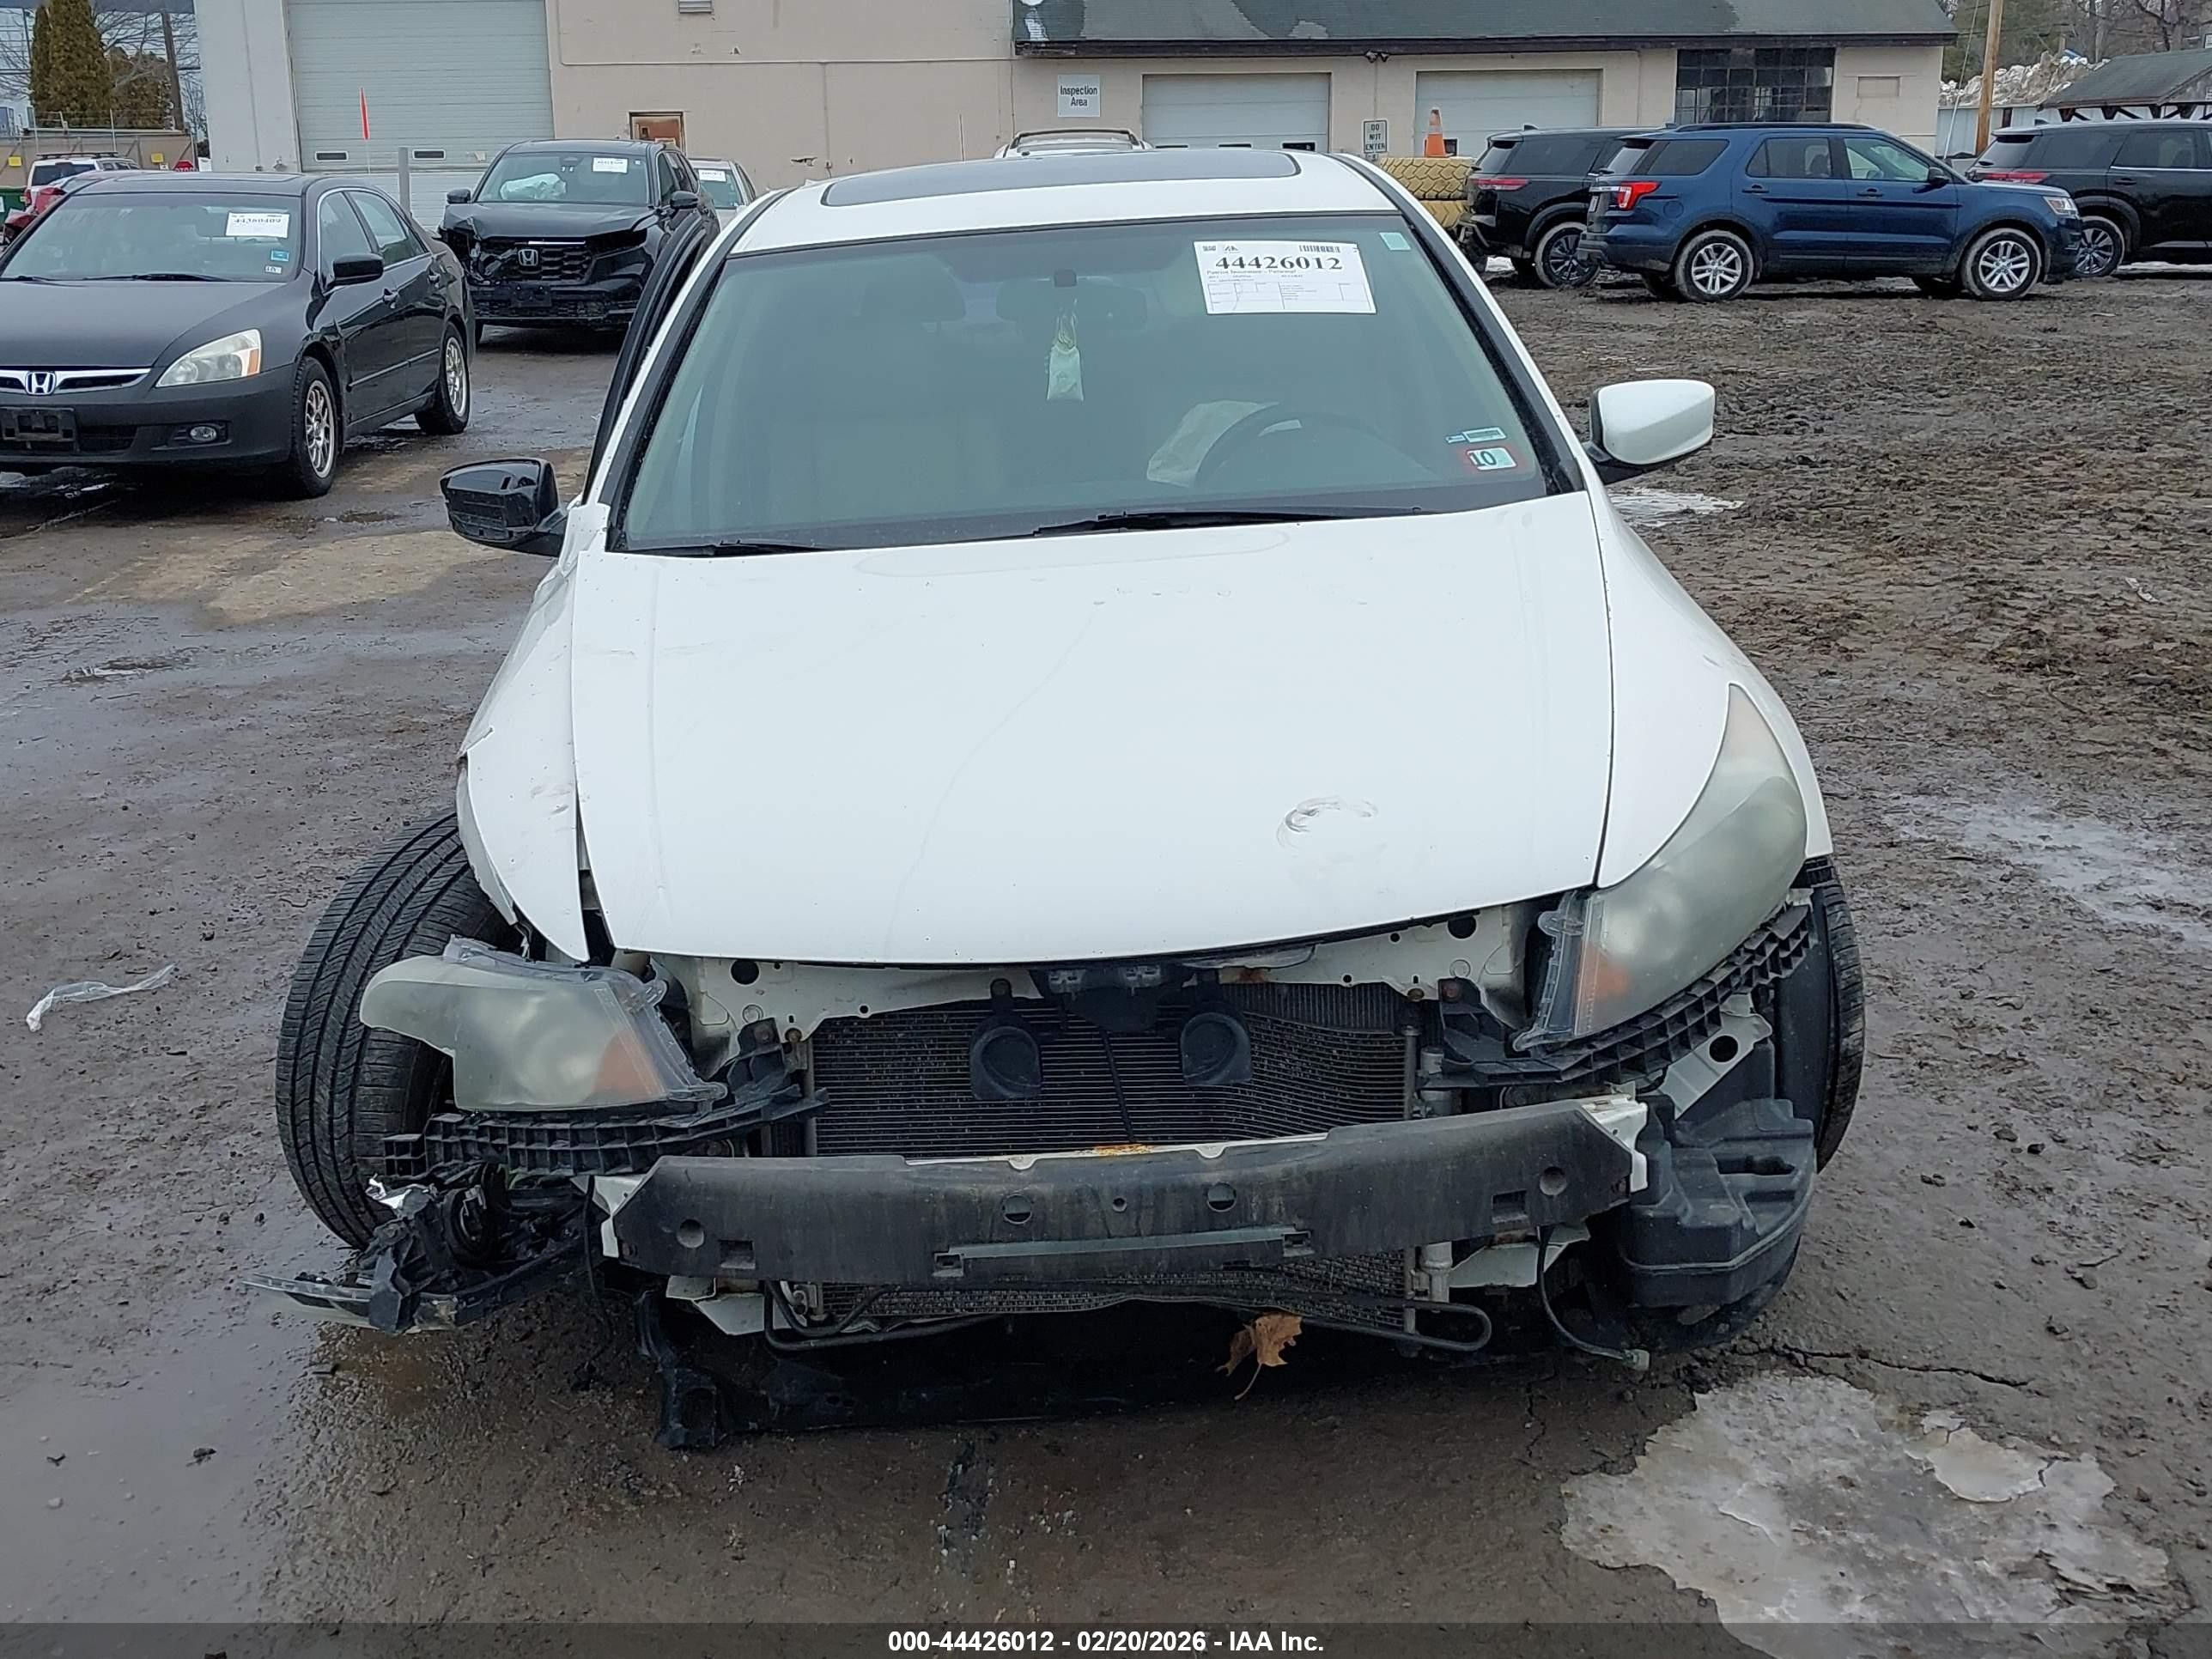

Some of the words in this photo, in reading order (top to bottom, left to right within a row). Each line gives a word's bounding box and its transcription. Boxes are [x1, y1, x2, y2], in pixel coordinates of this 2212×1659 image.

[1060, 85, 1098, 96] Inspection
[1070, 96, 1088, 106] Area
[1215, 256, 1343, 270] 44426012
[1469, 450, 1497, 467] 10
